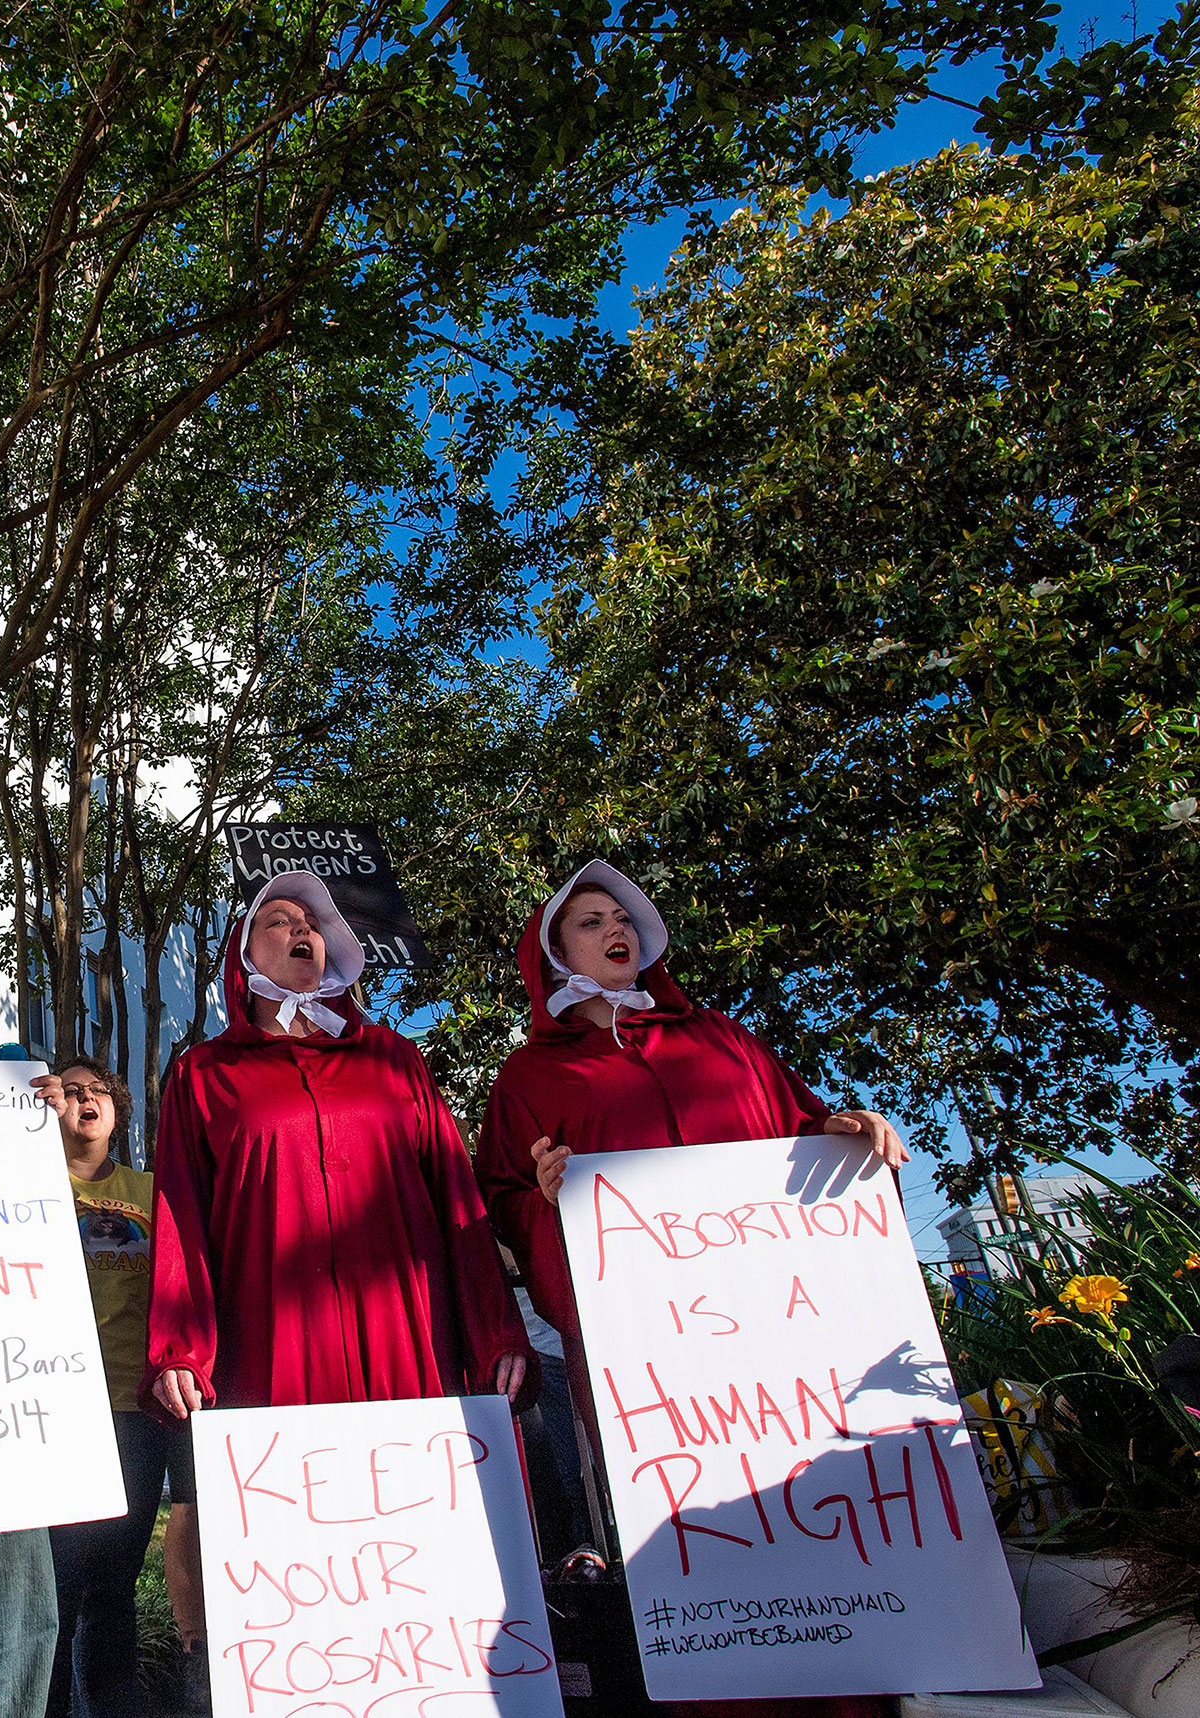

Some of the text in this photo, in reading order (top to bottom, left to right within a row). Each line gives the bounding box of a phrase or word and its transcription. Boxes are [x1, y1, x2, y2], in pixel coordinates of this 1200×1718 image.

[230, 826, 364, 855] Protect
[594, 1172, 890, 1282] ABORTION
[667, 1275, 820, 1336] IS A
[603, 1361, 851, 1453] HUMAN
[226, 1431, 490, 1538] KEEP
[631, 1417, 964, 1577] RIGHT
[224, 1541, 427, 1631] YOUR
[223, 1616, 554, 1714] ROSARIES
